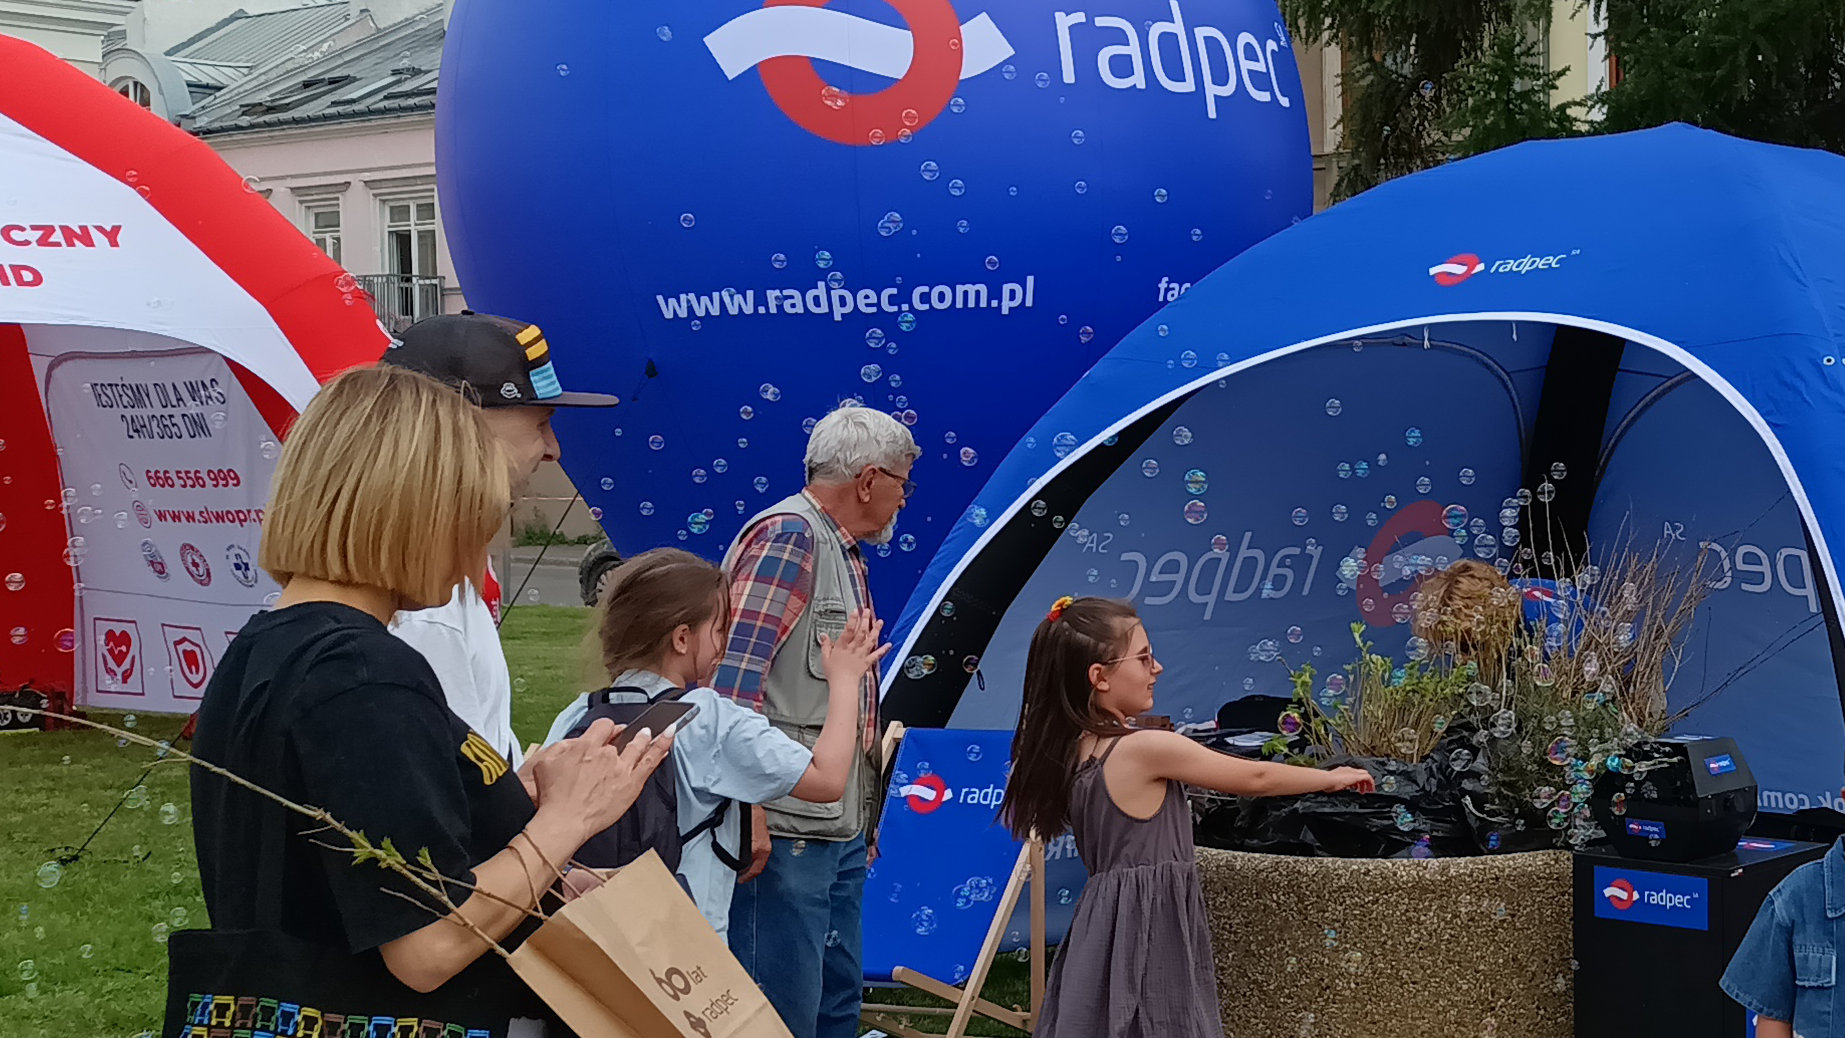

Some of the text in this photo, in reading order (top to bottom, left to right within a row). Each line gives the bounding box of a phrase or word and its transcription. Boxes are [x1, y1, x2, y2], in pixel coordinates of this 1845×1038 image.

[1055, 0, 1290, 118] radpec
[0, 224, 122, 248] CZNY
[1489, 254, 1567, 275] radpec
[656, 276, 1035, 321] www.radpec.com.pl
[153, 382, 185, 409] DLA
[183, 377, 227, 406] WAS
[120, 412, 213, 439] 24H/365 DNI
[145, 467, 242, 489] 666 556 999
[1643, 889, 1692, 910] radpec
[686, 965, 709, 985] lat
[701, 989, 739, 1022] radpec
